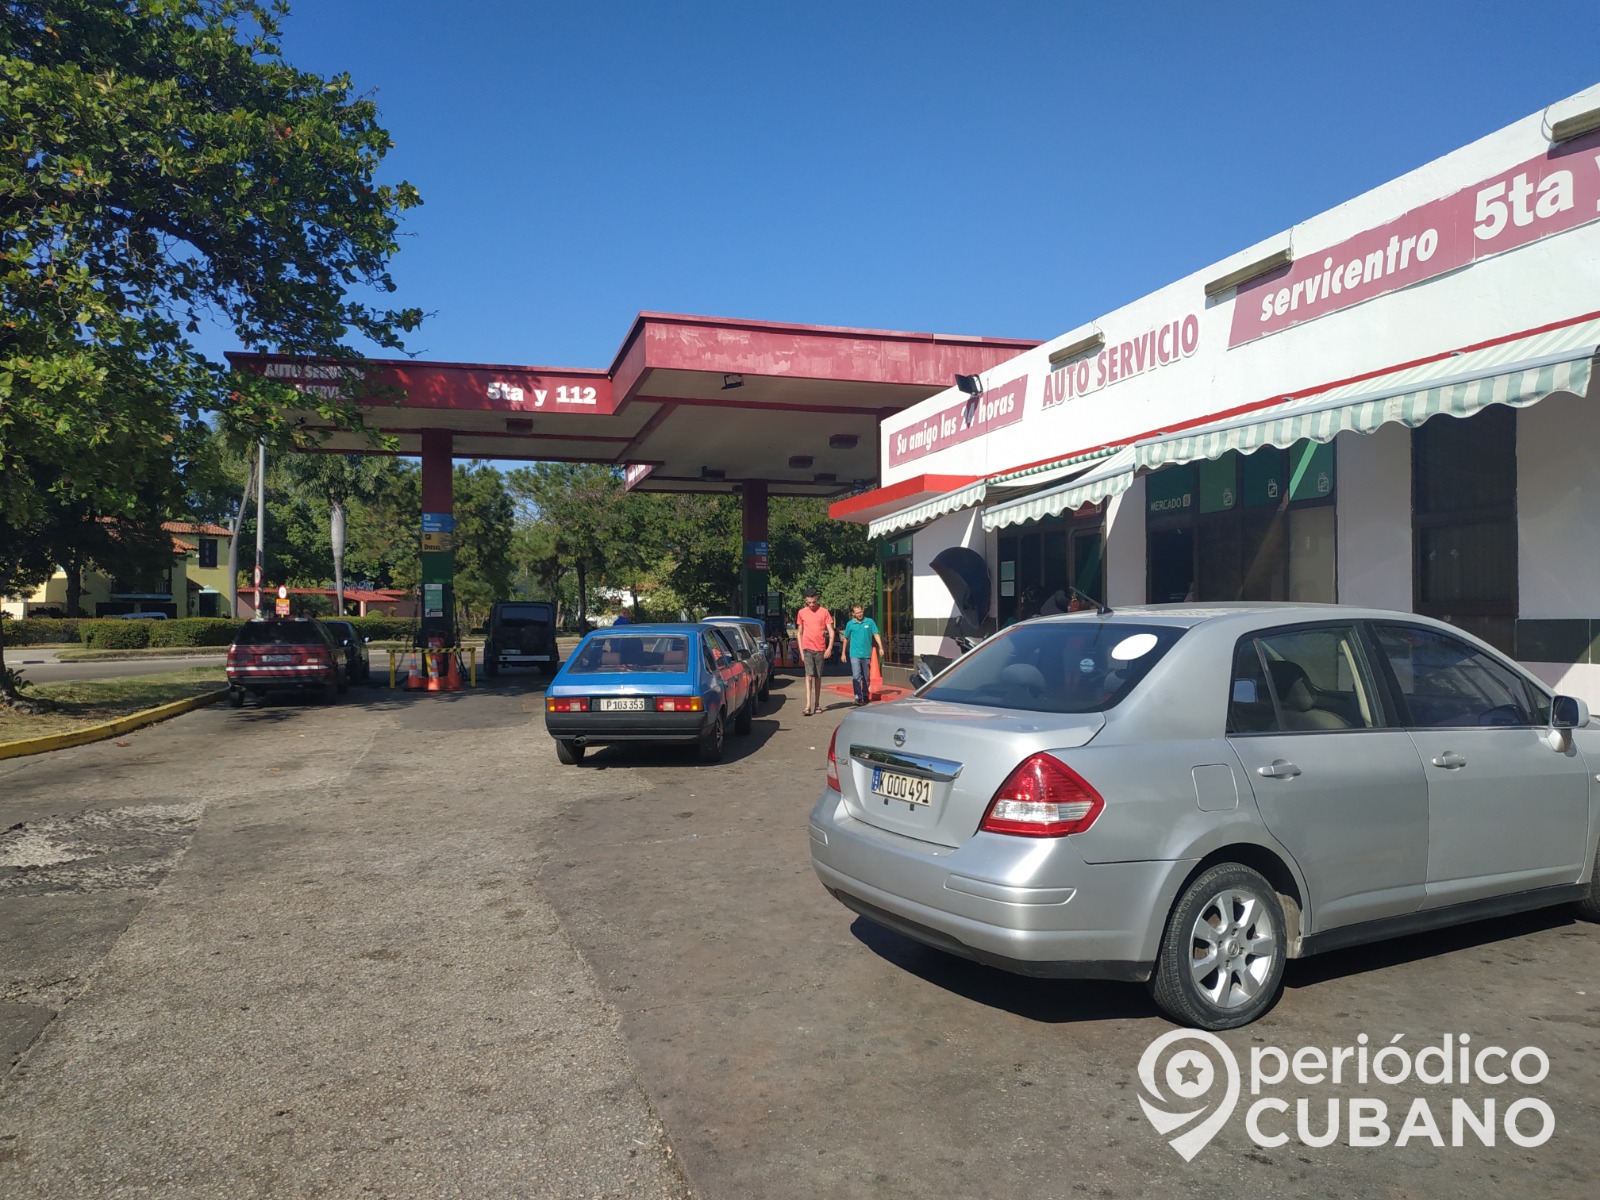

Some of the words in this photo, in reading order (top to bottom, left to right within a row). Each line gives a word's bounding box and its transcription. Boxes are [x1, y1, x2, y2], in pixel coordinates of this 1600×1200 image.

[1259, 228, 1438, 322] servicentro
[1473, 169, 1574, 240] 5ta
[1042, 361, 1090, 407] AUTO
[1097, 313, 1199, 387] SERVICIO
[487, 382, 524, 402] 5ta
[534, 389, 548, 407] y
[556, 385, 596, 405] 112
[896, 433, 907, 456] Su
[909, 422, 938, 451] amigo
[941, 413, 957, 438] las
[978, 392, 1015, 424] horas
[1150, 497, 1182, 511] MERCADO
